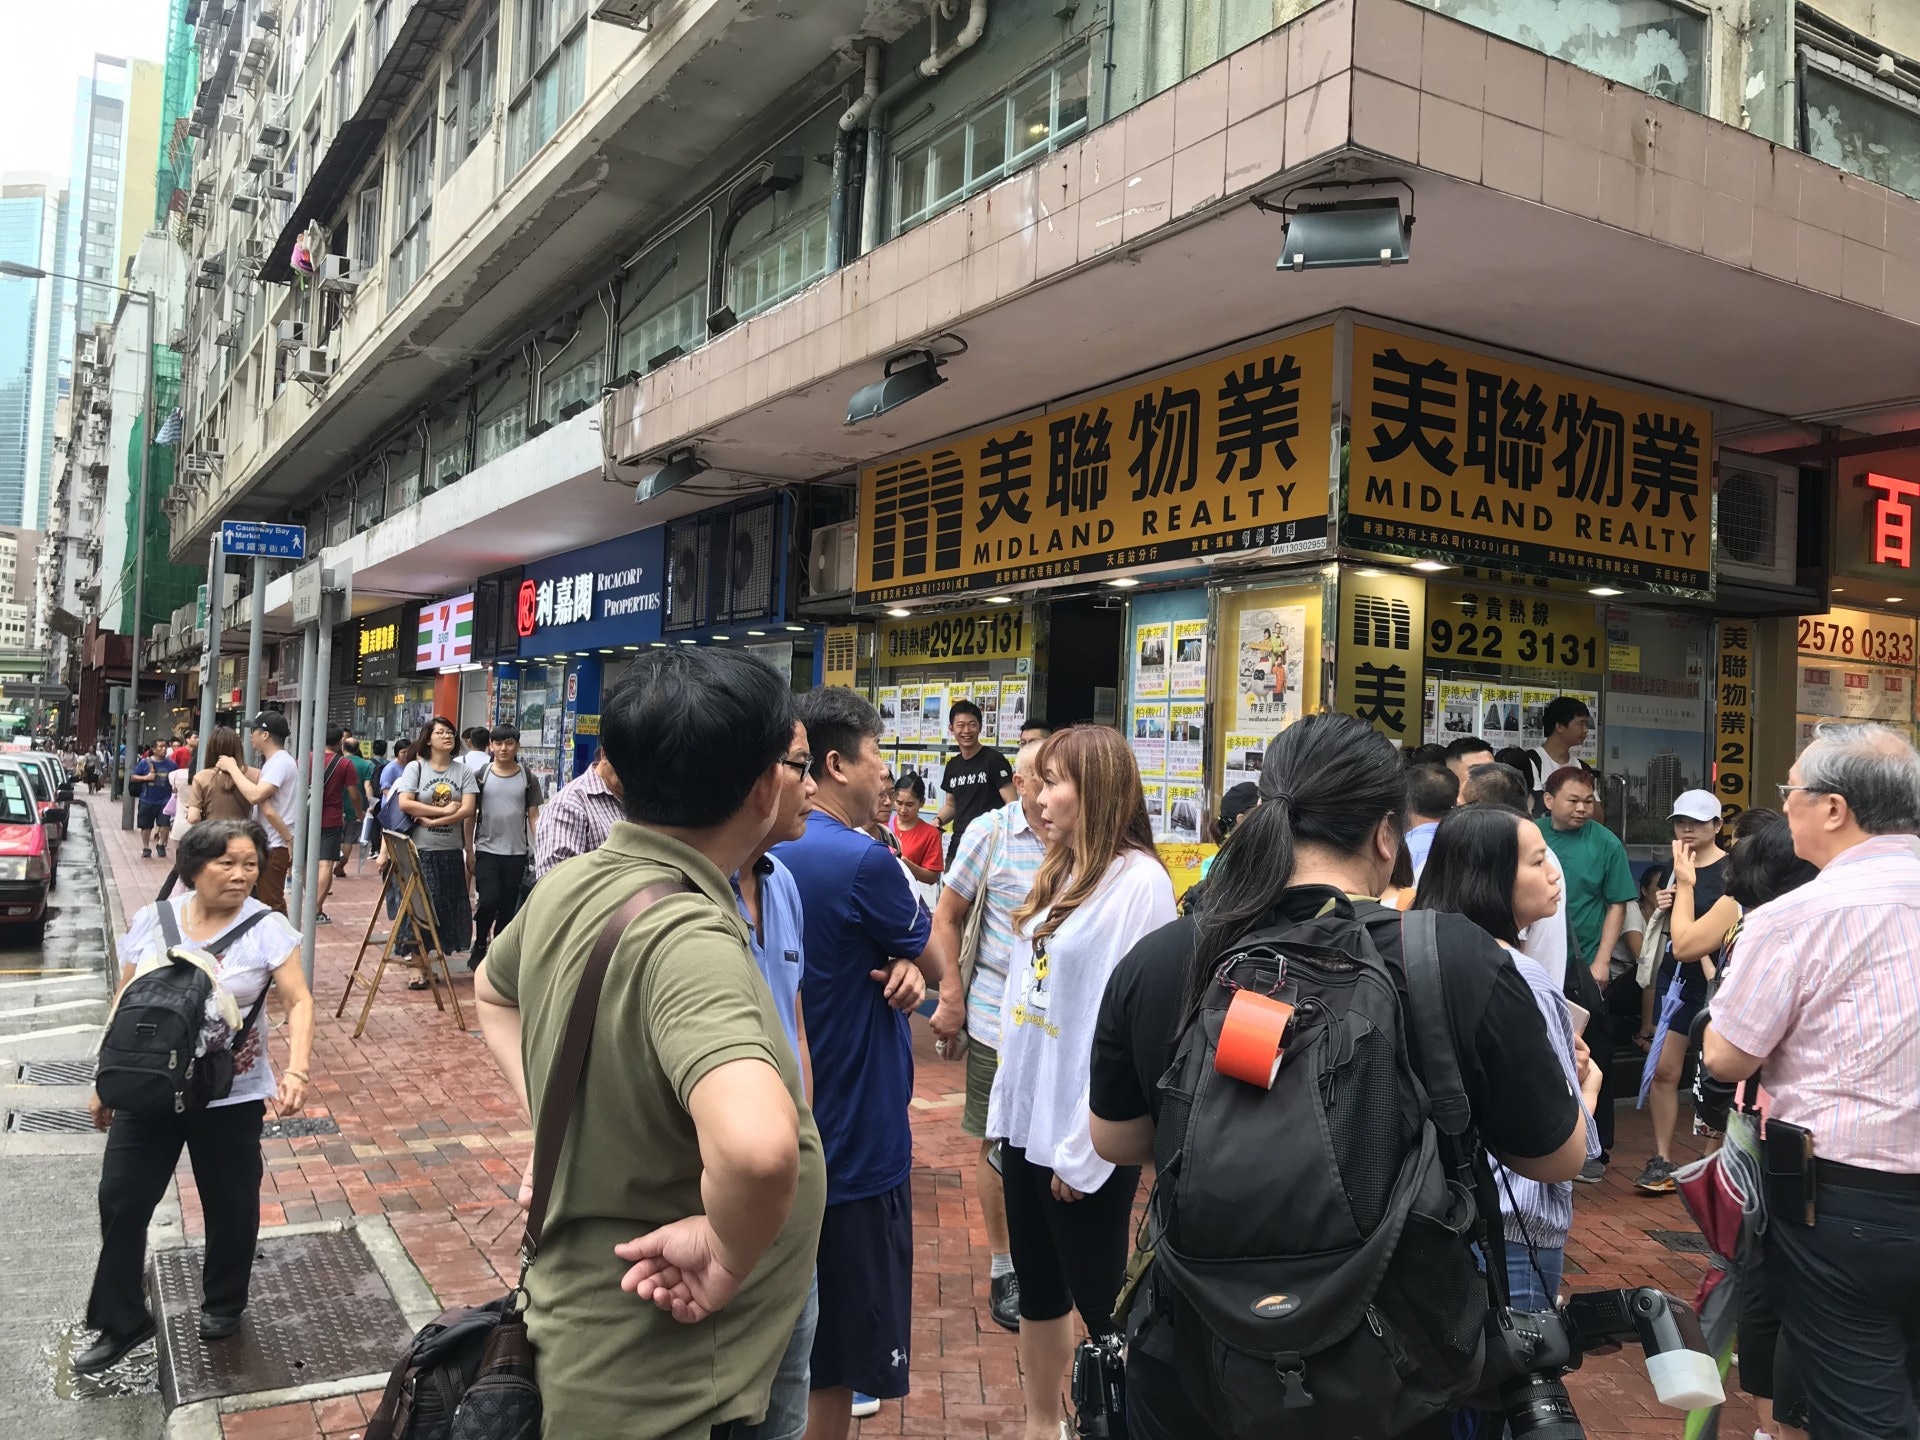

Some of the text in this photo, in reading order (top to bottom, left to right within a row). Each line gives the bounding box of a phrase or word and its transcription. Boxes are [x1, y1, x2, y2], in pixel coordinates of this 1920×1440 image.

[974, 354, 1303, 534] 美聯物業
[1366, 348, 1701, 523] 美聯物業
[236, 525, 290, 535] Causeway Bay
[973, 518, 1116, 566] MIDLAND
[1142, 481, 1298, 536] REALTY
[1365, 475, 1697, 558] MIDLAND REALTY
[1866, 471, 1920, 569] 百
[1106, 546, 1158, 567] 天后站分行
[1271, 538, 1327, 556] MW130302955
[1362, 521, 1521, 557] 香港聯交所上市公司(1200)成員
[1655, 567, 1697, 584] 天后站分行
[536, 572, 593, 626] 利嘉閣
[1460, 592, 1549, 627] 尊貴熱線
[888, 610, 1024, 658] 尊貴熱線 29223131
[1517, 629, 1597, 668] 3131
[1798, 618, 1914, 662] 2578 0333
[1354, 661, 1407, 733] 美
